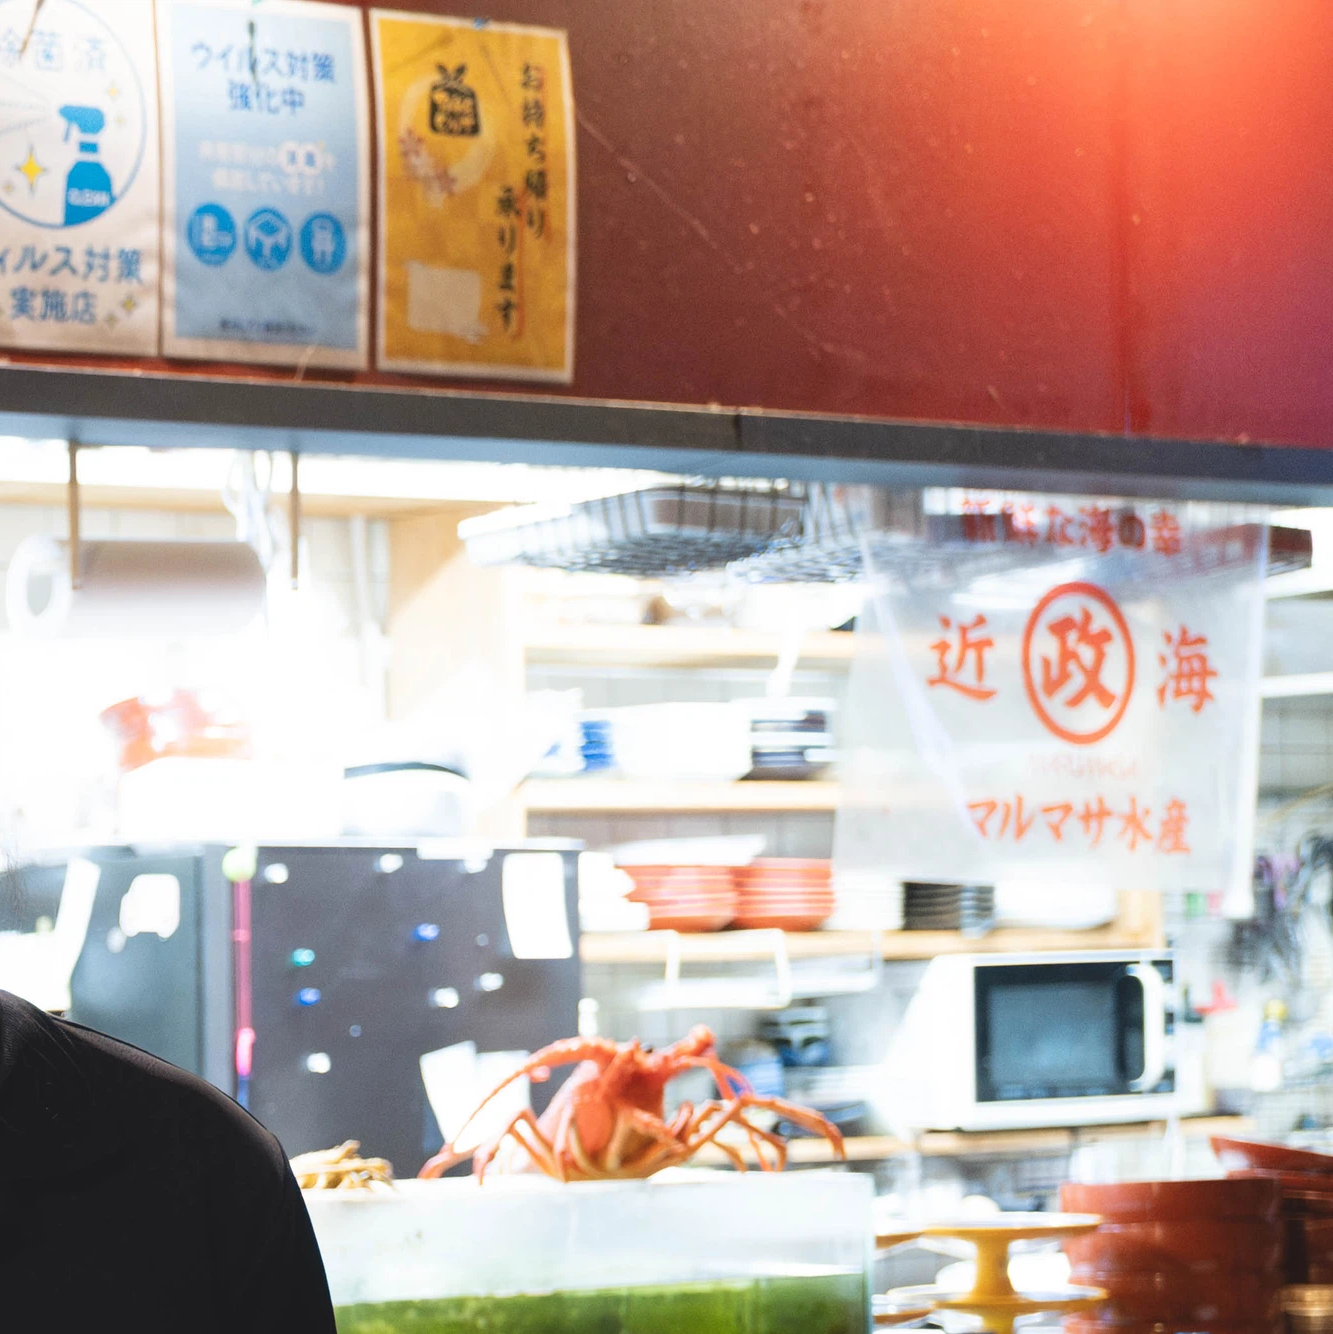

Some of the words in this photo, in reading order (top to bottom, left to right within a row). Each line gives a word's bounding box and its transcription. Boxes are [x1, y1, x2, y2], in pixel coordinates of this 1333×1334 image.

[9, 287, 97, 325] 実施店
[927, 613, 996, 700] 近
[1039, 606, 1117, 709] 政
[1156, 625, 1219, 714] 海
[967, 795, 1191, 854] マルマサ水産
